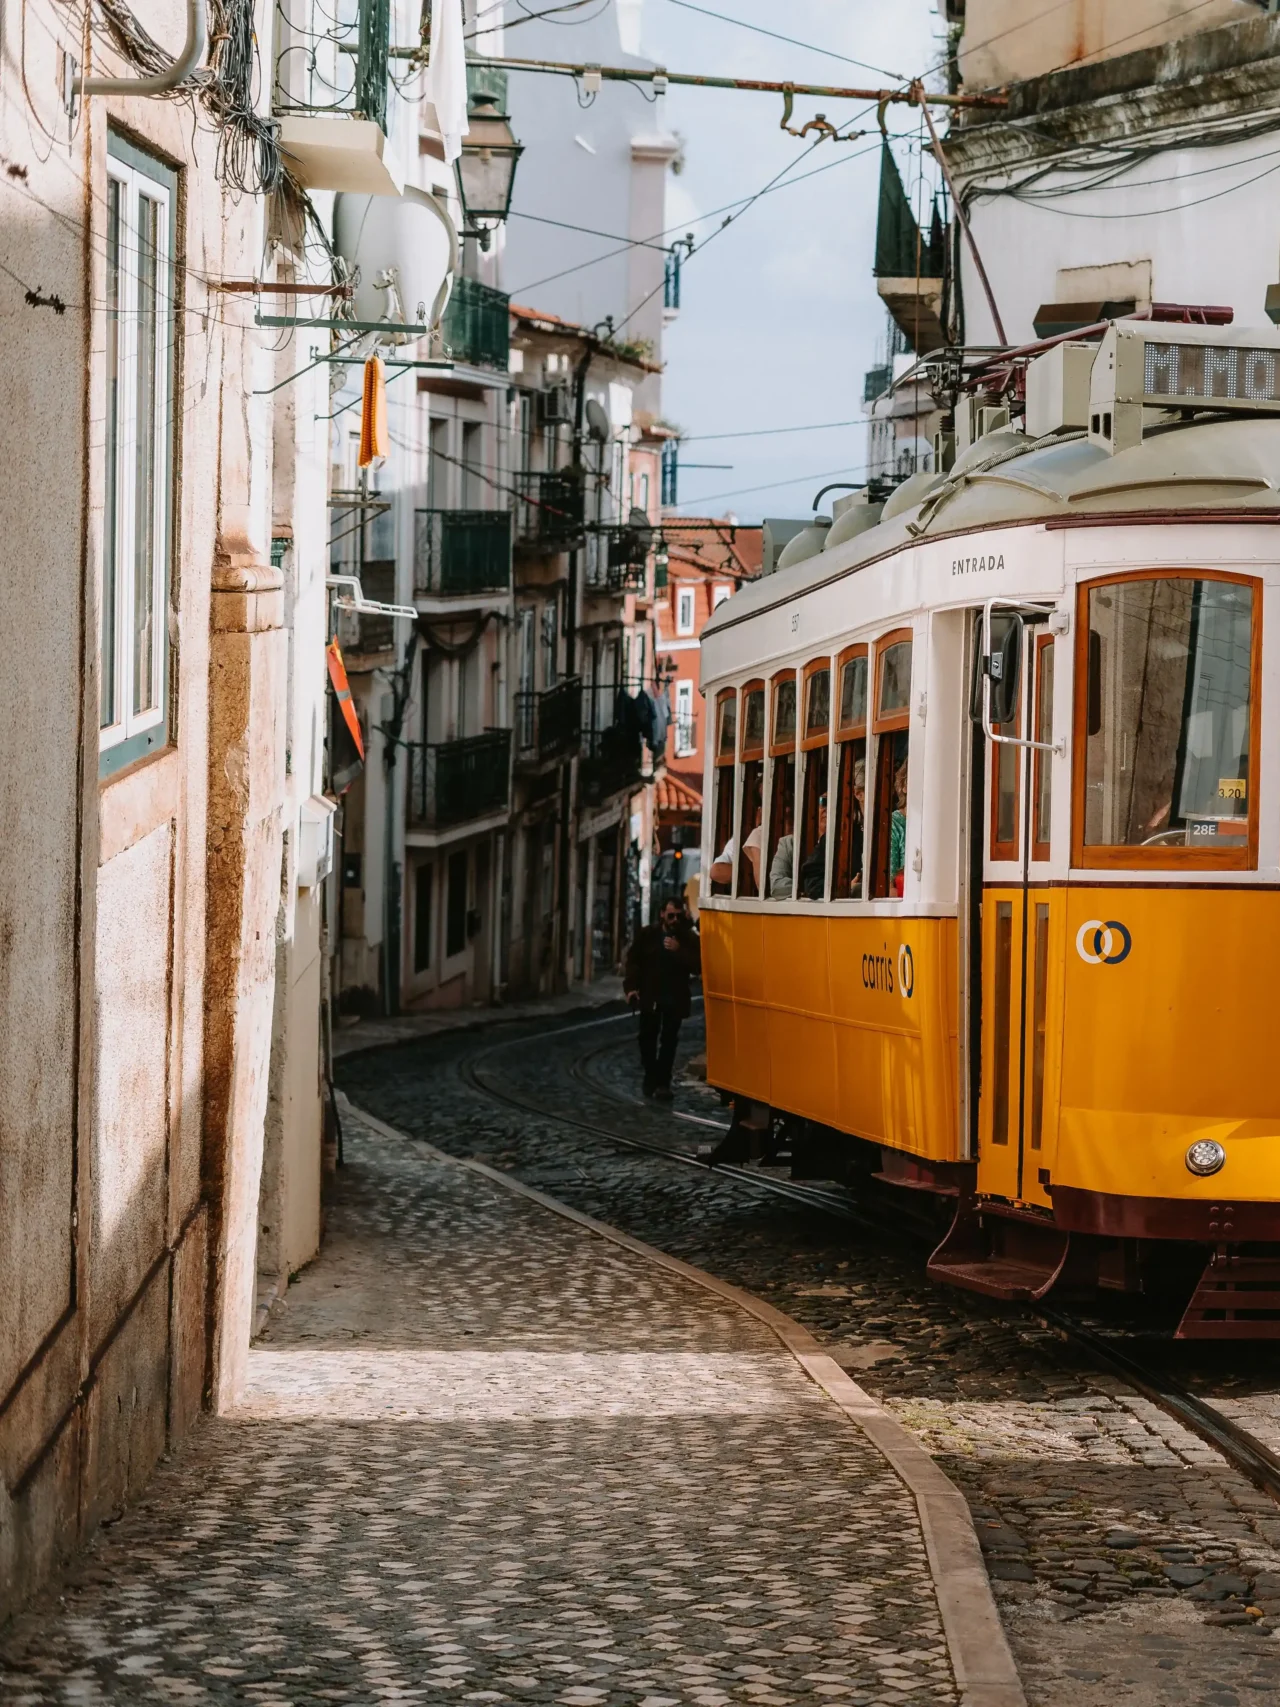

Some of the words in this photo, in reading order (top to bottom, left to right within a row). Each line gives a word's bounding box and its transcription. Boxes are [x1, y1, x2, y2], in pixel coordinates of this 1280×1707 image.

[952, 554, 1005, 576] ENTRADA
[1218, 788, 1241, 799] 3.20
[1193, 824, 1216, 835] 28E
[862, 941, 893, 993] carris
